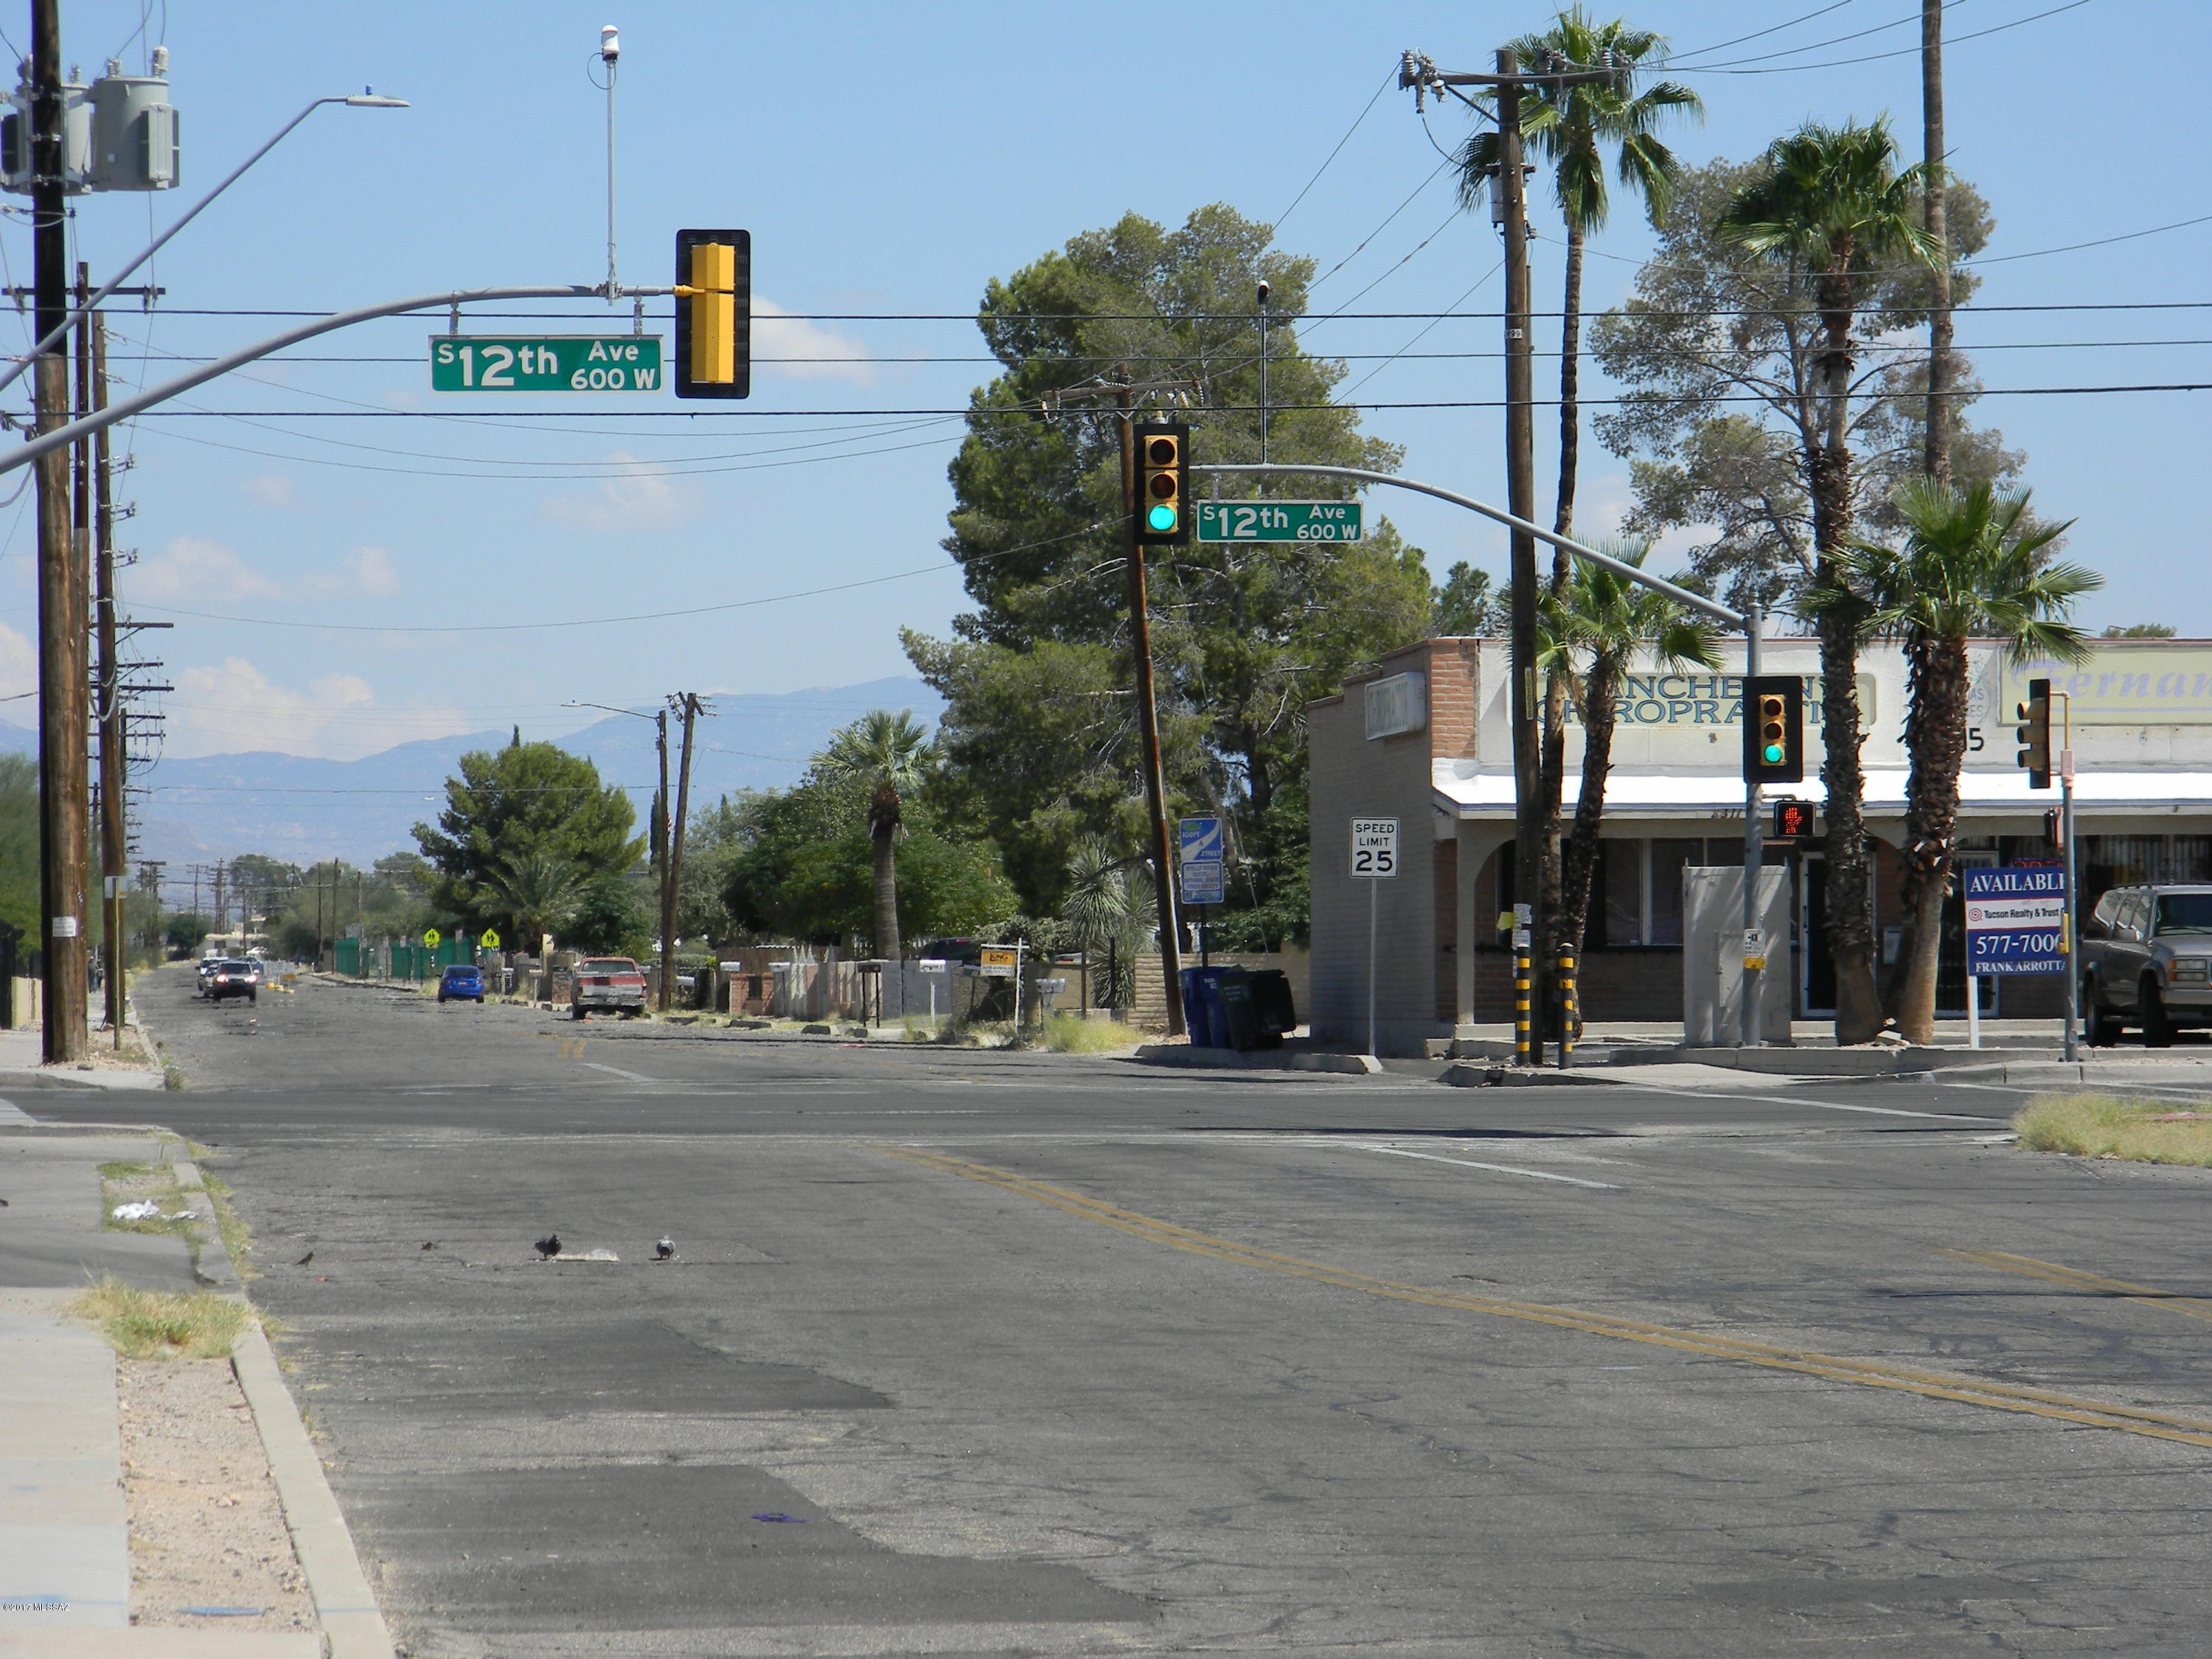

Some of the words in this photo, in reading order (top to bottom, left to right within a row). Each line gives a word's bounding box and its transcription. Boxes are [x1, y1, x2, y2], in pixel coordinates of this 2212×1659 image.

[437, 344, 454, 364] S
[459, 344, 557, 386] 12th
[588, 341, 639, 361] Ave
[571, 369, 625, 389] 600
[634, 369, 655, 389] W
[1203, 506, 1215, 520] S
[1218, 507, 1288, 537] 12th
[1309, 504, 1346, 519] Ave
[1296, 524, 1335, 540] 600
[1342, 524, 1357, 539] W
[1964, 728, 1984, 751] 5
[1356, 824, 1394, 833] SPEED
[1359, 838, 1390, 846] LIMIT
[1356, 850, 1393, 872] 25
[1984, 909, 2009, 919] Tucson
[2010, 908, 2034, 919] Realty
[2034, 908, 2040, 917] &
[2042, 908, 2059, 917] Trust
[1975, 961, 2014, 973] FRANK
[2015, 959, 2065, 972] ARROTT
